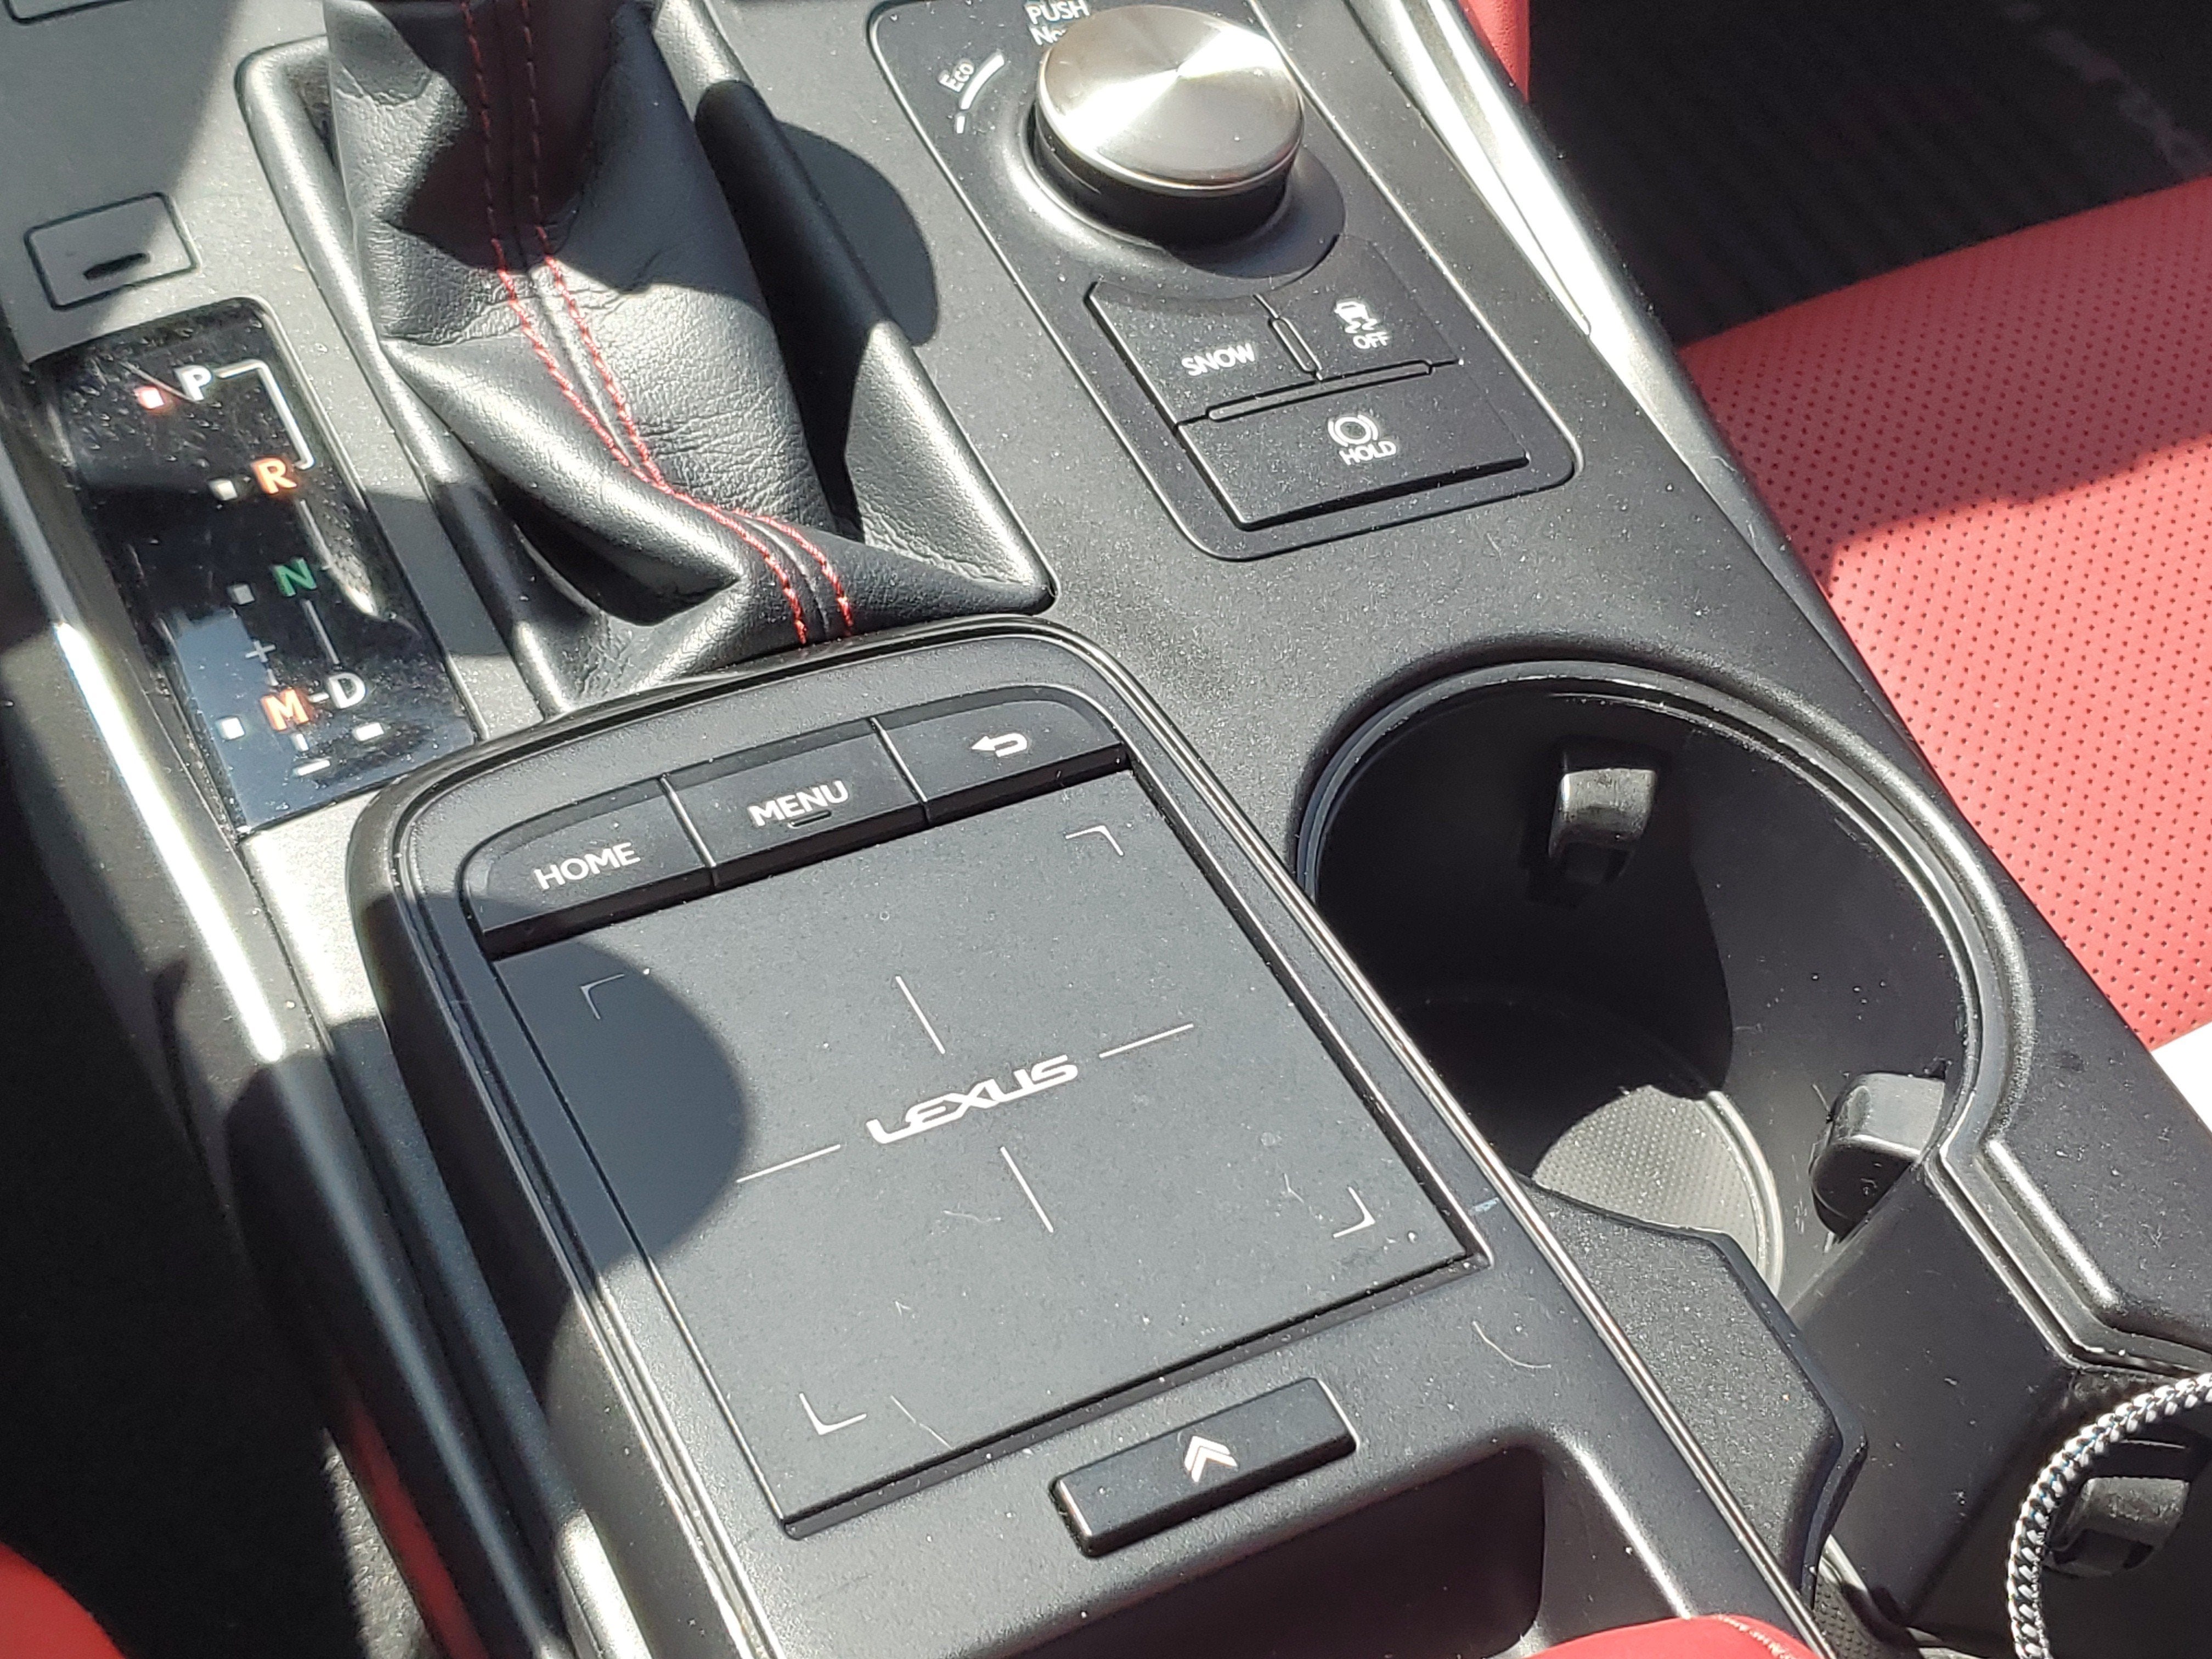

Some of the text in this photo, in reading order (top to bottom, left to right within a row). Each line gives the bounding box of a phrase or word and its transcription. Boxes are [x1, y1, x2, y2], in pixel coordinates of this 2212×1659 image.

[1025, 0, 1090, 24] PUSH
[1181, 343, 1255, 376] SNOW
[1353, 331, 1391, 349] OFF
[176, 365, 213, 402] P
[1339, 441, 1397, 465] HOLD
[251, 456, 297, 495] R
[272, 557, 317, 596] N
[261, 673, 366, 732] M D
[748, 780, 849, 827] MENU
[534, 842, 641, 890] HOME
[866, 1054, 1078, 1144] LEXUS
